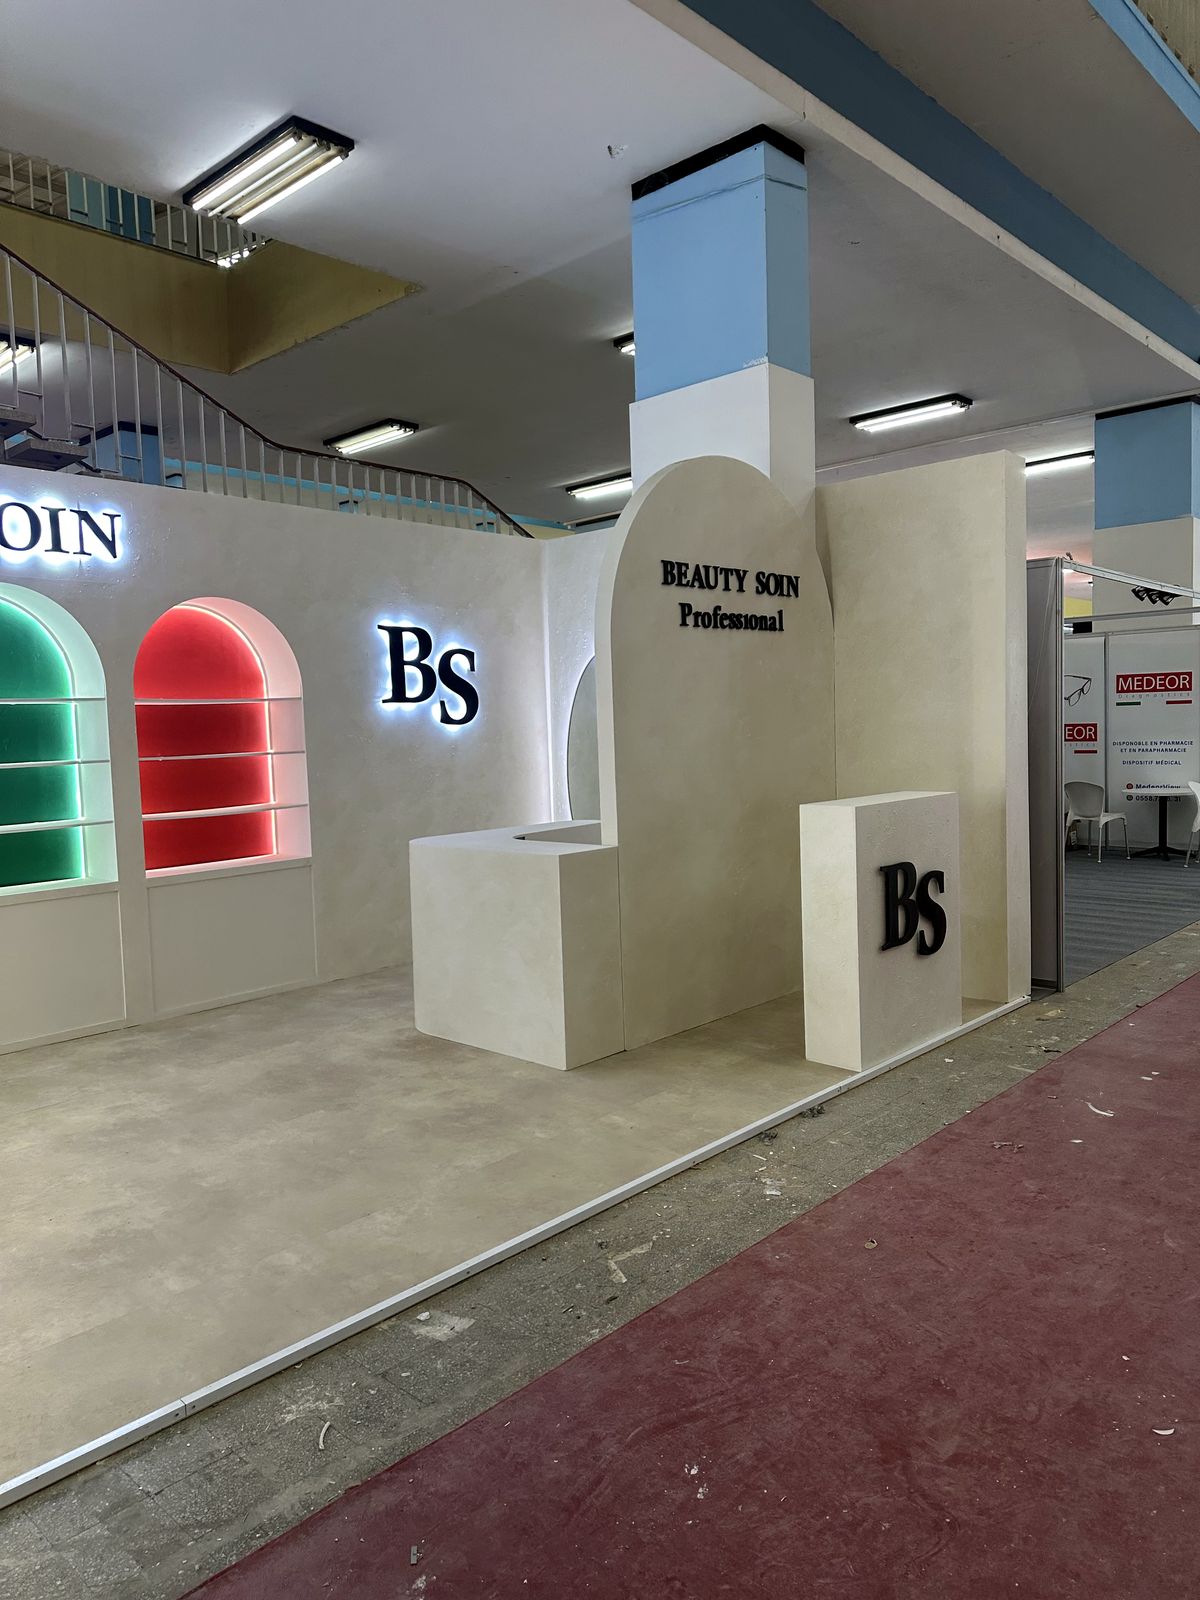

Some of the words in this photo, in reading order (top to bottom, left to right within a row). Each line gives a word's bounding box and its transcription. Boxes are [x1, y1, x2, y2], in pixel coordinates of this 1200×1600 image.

[661, 560, 748, 592] BEAUTY
[755, 571, 800, 598] SOIN
[678, 602, 784, 631] Professional
[1118, 674, 1190, 691] MEDEOR
[879, 861, 947, 956] BS
